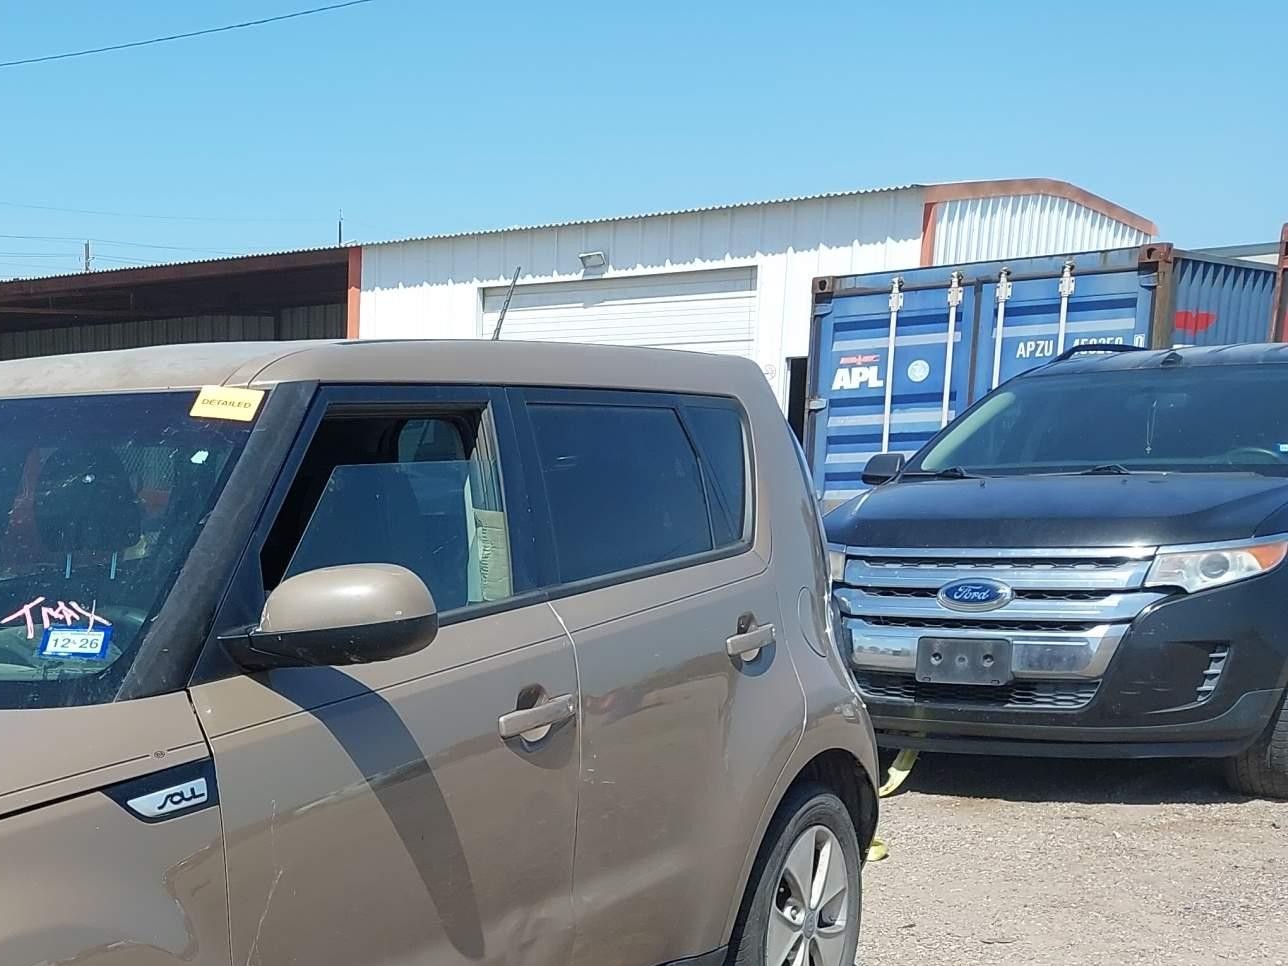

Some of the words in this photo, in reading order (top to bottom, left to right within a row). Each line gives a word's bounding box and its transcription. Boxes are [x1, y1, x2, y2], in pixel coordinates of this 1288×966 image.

[1015, 339, 1054, 359] APZU
[831, 365, 884, 391] APL
[201, 398, 252, 409] DETAILED
[953, 585, 991, 600] Ford
[52, 637, 71, 648] 12
[78, 638, 100, 649] 26
[157, 787, 206, 810] SOUL
